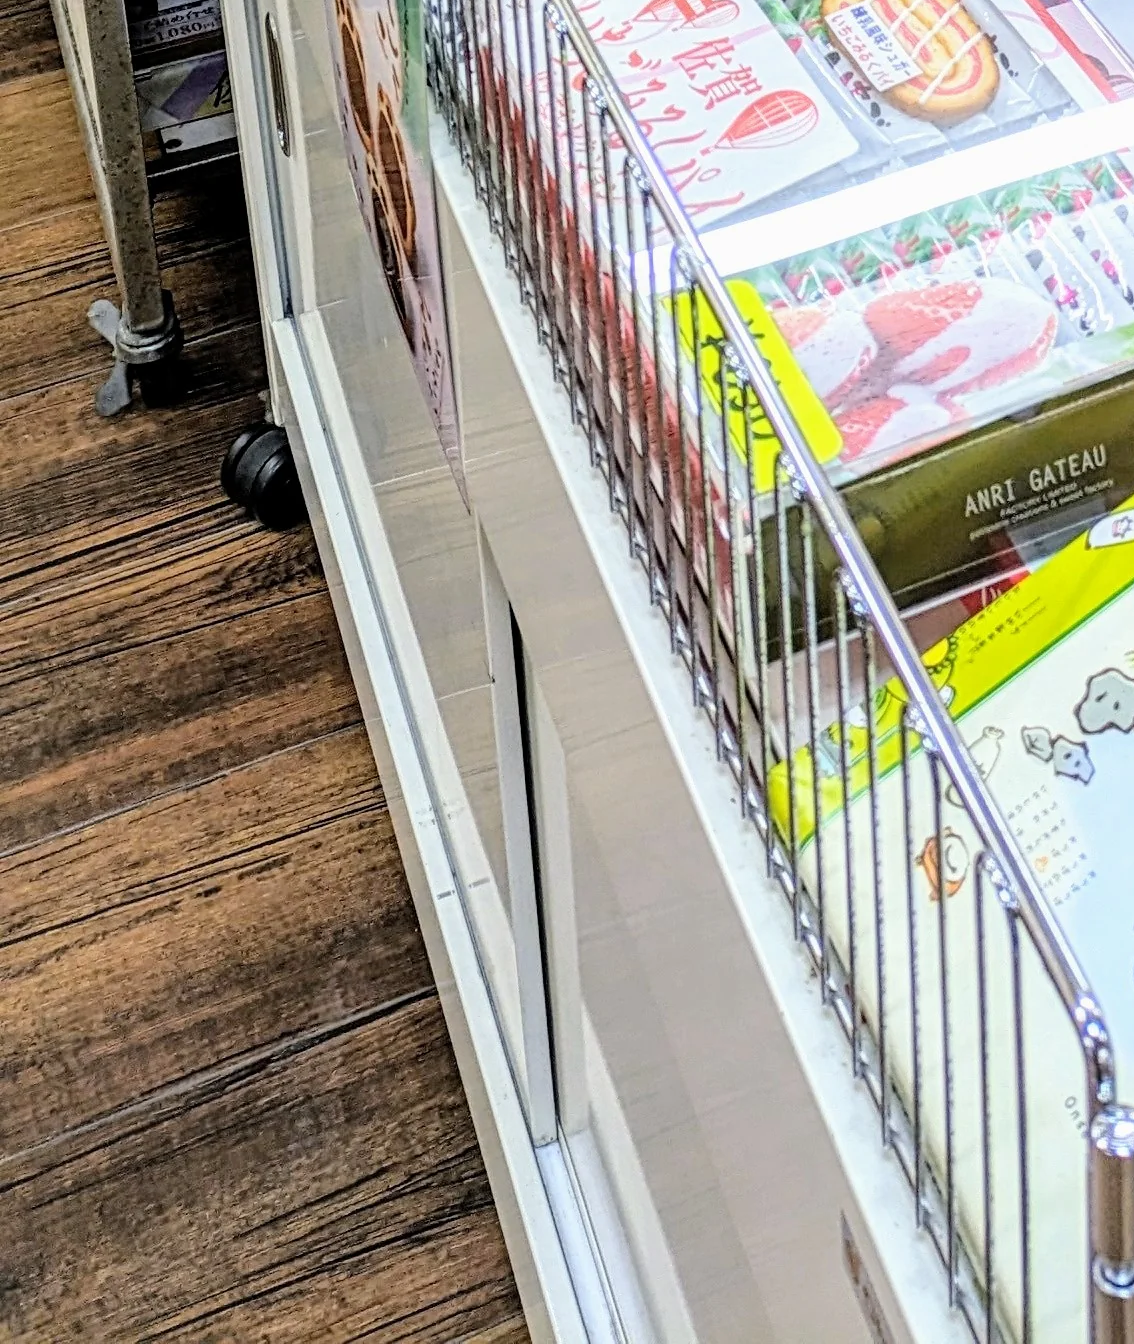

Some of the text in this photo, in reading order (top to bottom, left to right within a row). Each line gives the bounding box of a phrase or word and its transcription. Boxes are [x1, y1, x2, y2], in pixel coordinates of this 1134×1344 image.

[671, 37, 763, 111] 佐賀
[829, 13, 897, 90] いちごみるくパイ
[964, 477, 1018, 518] ANRI
[1028, 443, 1107, 493] GATEAU
